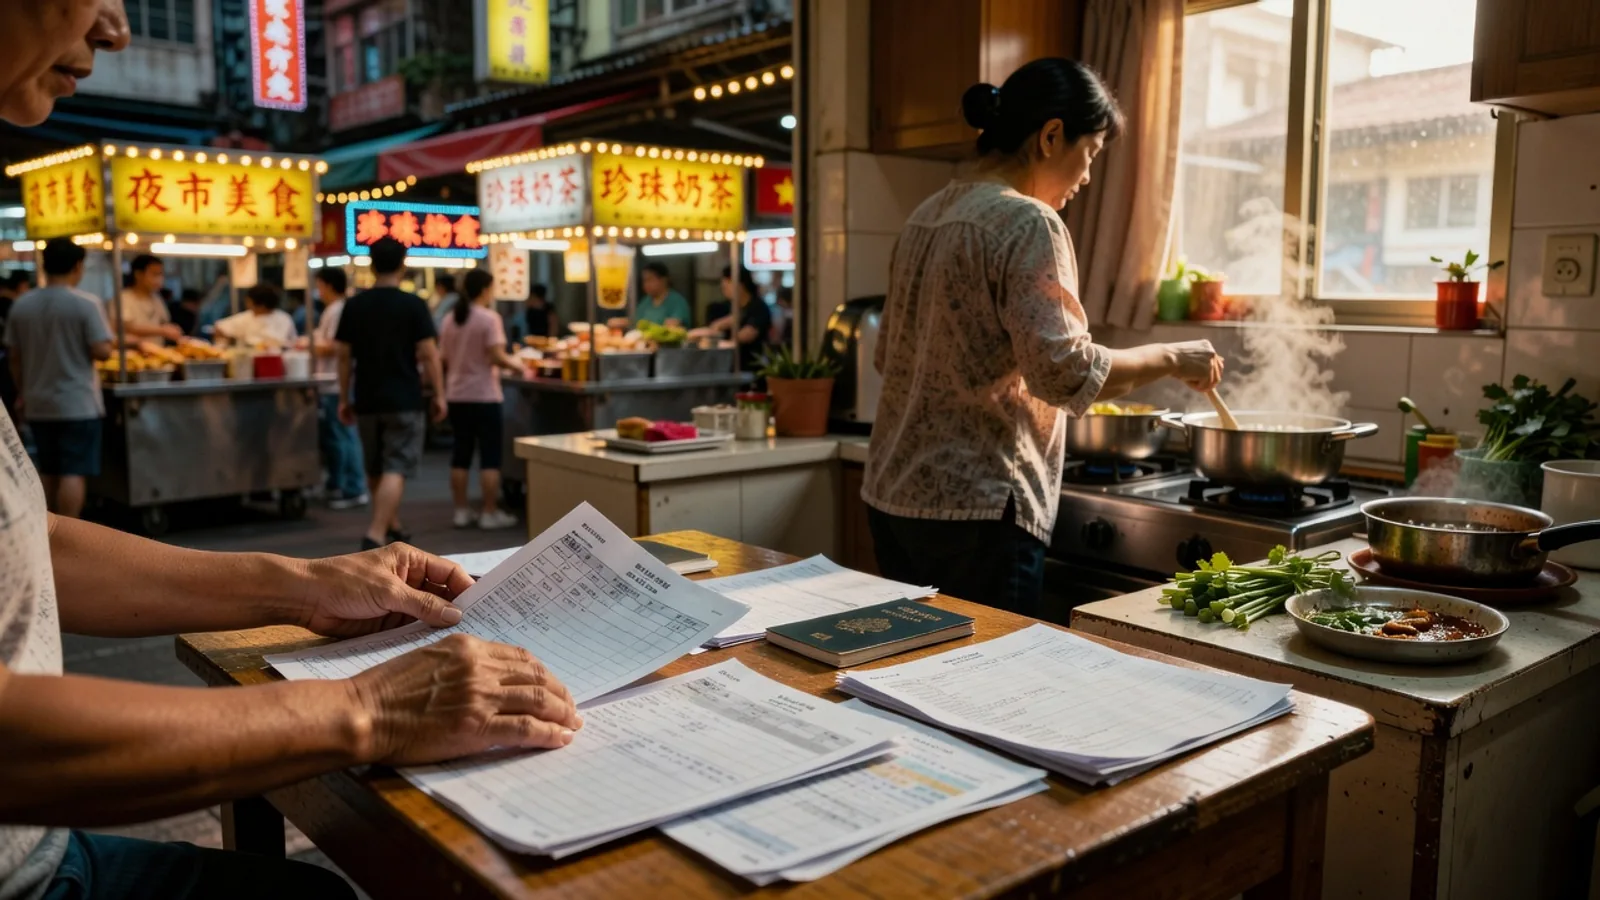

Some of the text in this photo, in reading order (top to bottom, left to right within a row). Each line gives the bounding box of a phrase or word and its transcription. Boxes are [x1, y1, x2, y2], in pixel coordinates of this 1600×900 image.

[29, 169, 97, 217] 夜市美食
[128, 167, 301, 219] 夜市美食
[486, 166, 580, 212] 珍珠奶茶
[600, 164, 734, 211] 珍珠奶茶
